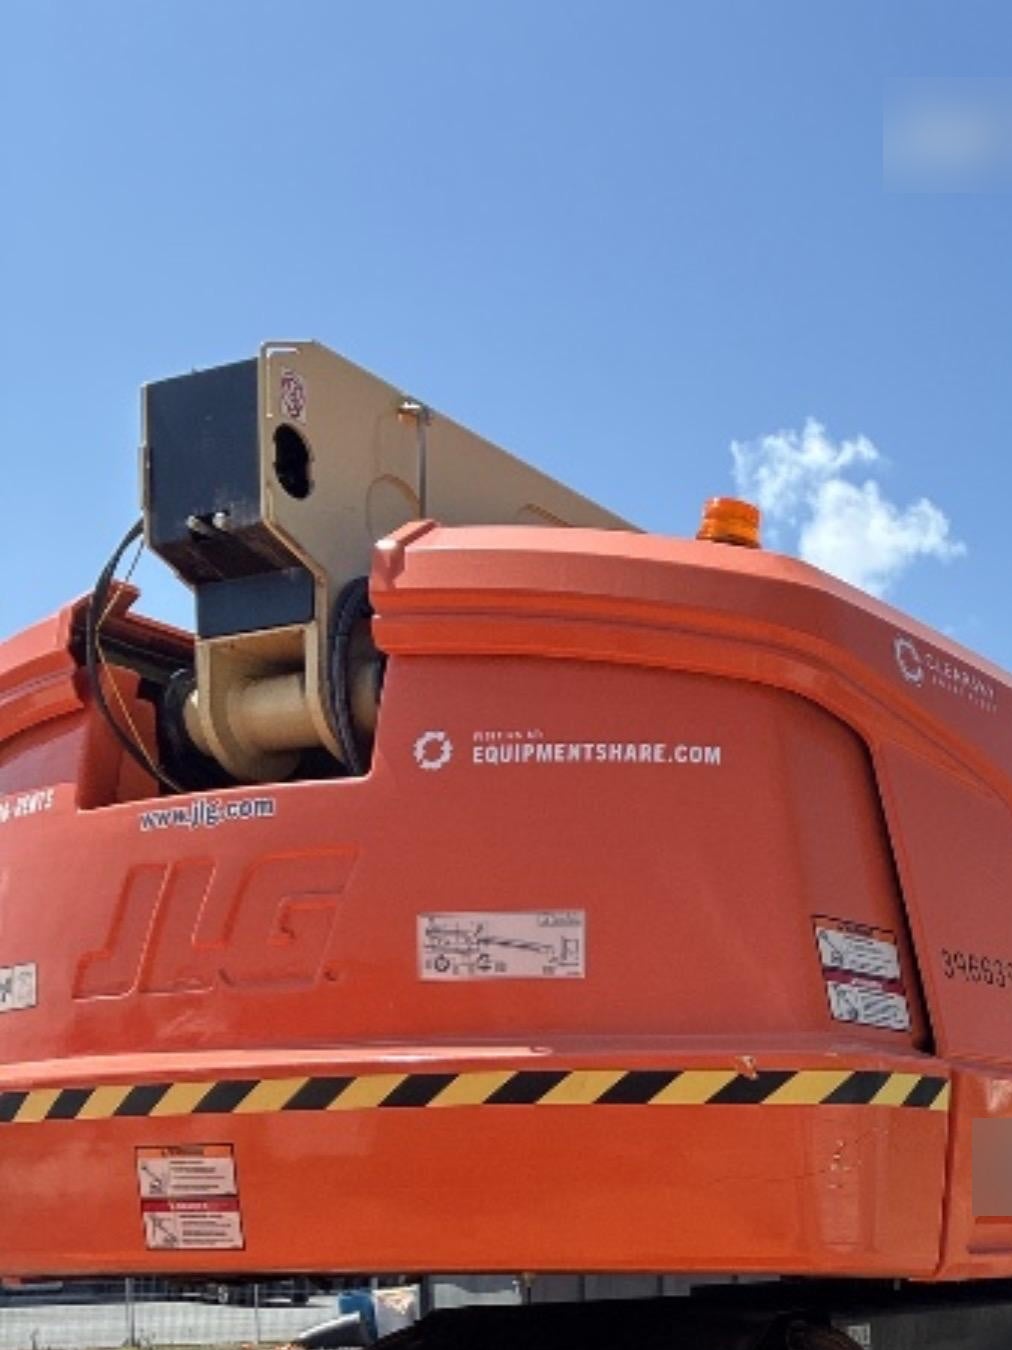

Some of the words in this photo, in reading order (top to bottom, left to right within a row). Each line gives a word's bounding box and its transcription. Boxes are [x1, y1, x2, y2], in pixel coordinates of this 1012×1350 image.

[472, 742, 722, 766] EQUIPMENTSHARE.COM
[139, 798, 275, 832] www.jlg.com
[71, 843, 360, 1002] JLG
